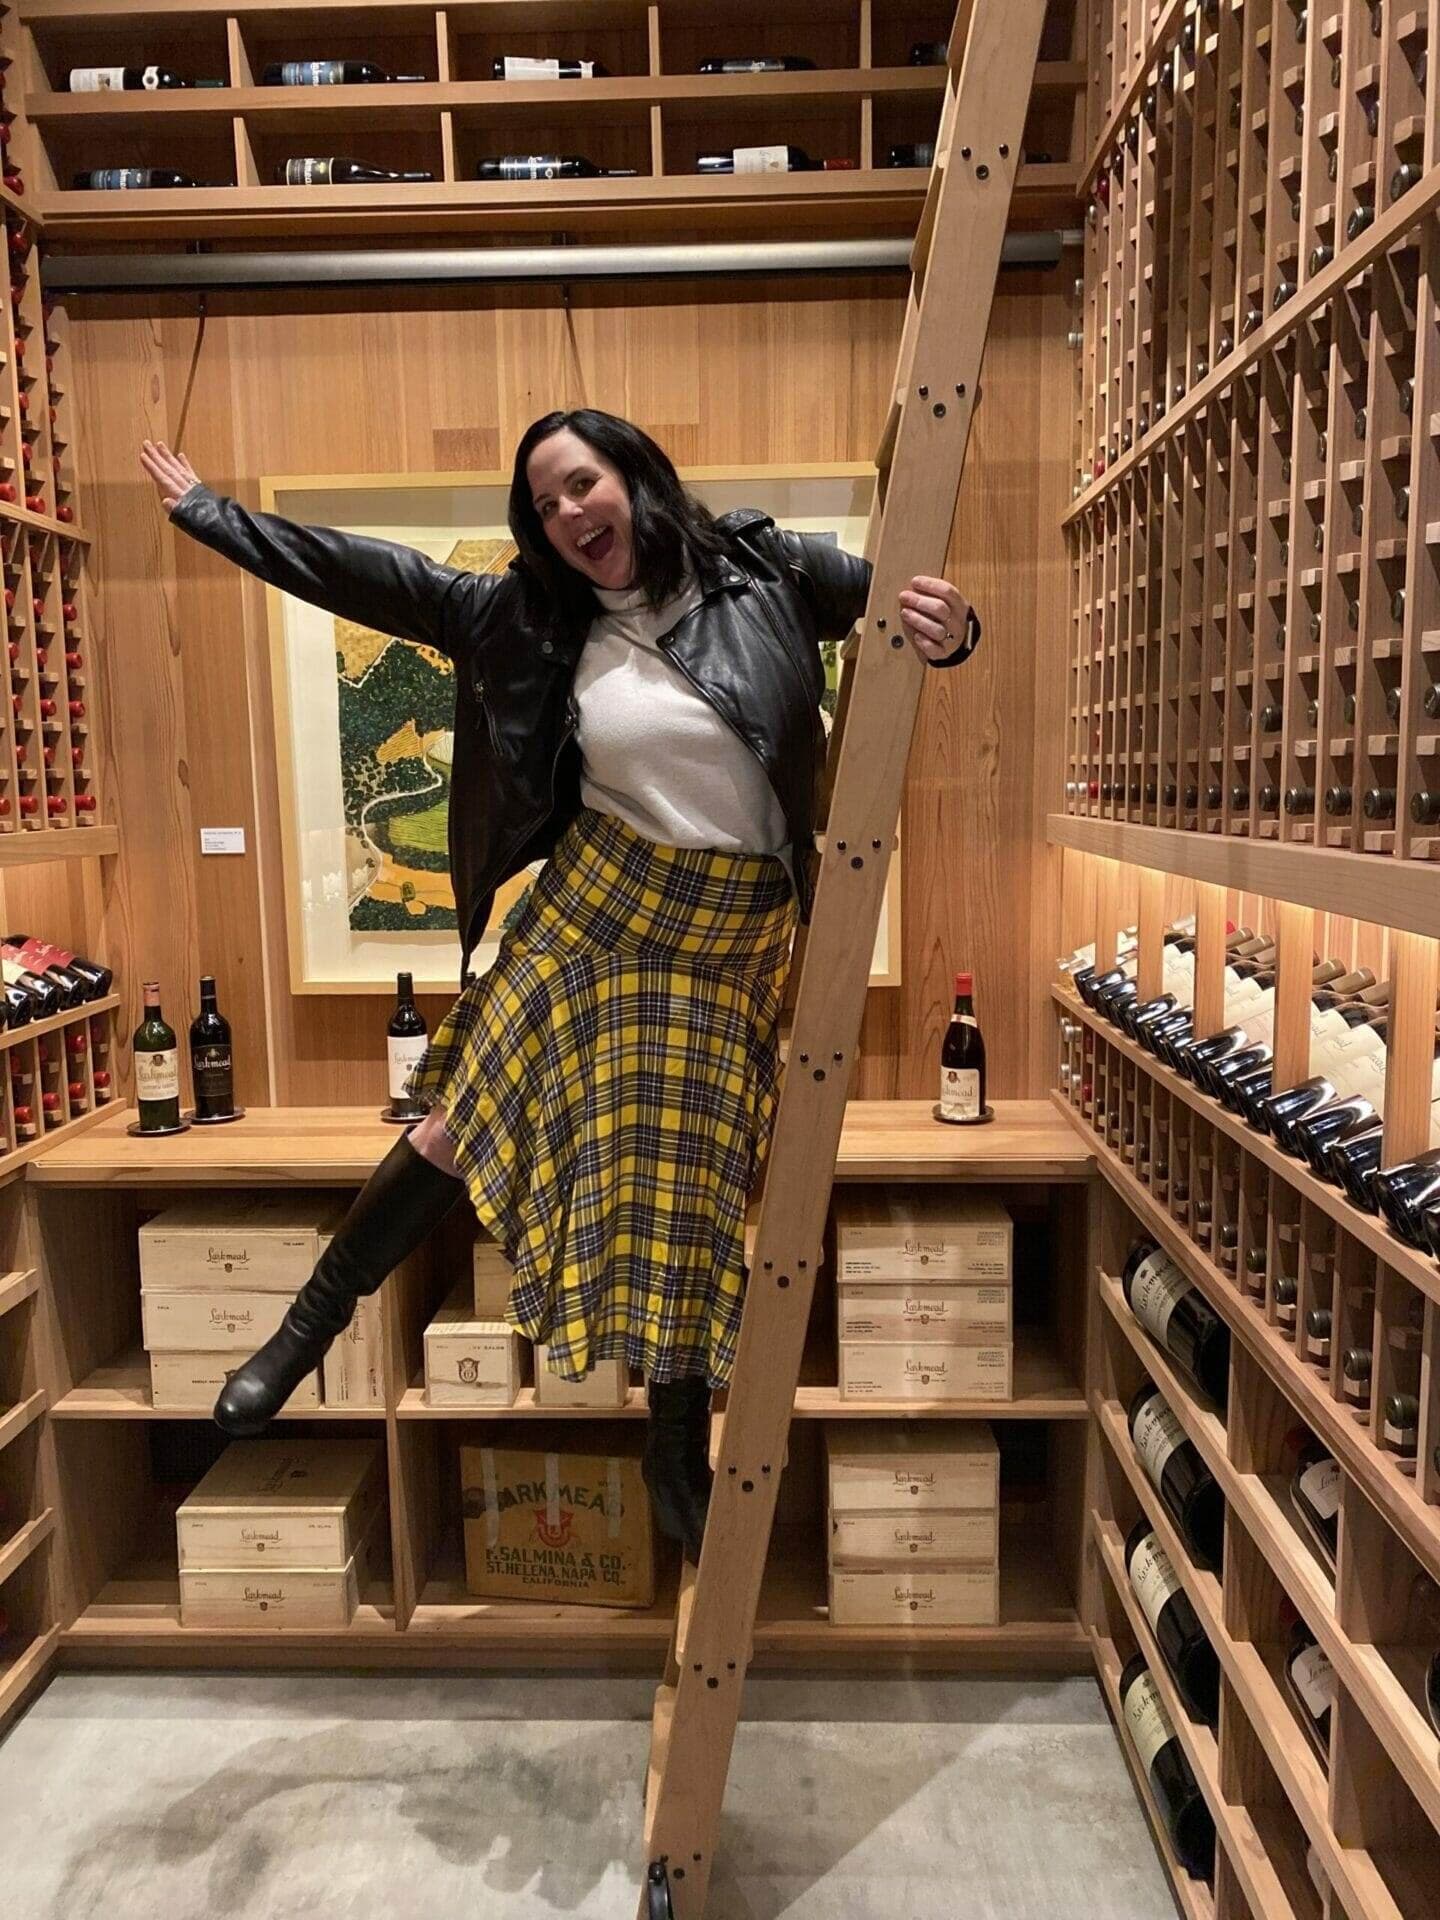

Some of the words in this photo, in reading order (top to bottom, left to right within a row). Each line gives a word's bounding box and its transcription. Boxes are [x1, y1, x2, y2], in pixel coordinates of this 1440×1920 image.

[206, 1247, 250, 1263] Larkmead
[902, 1240, 948, 1256] Larkmead
[903, 1298, 949, 1315] Larkmead
[209, 1308, 254, 1324] Larkmead
[904, 1360, 948, 1376] Larkmead
[893, 1470, 937, 1486] Larkmead
[240, 1528, 283, 1544] Larkmead
[894, 1528, 936, 1544] Larkmead
[581, 1552, 595, 1569] &
[521, 1576, 590, 1589] CALIFORNIA
[243, 1587, 287, 1603] Larkmead
[892, 1585, 937, 1602] Larkmead
